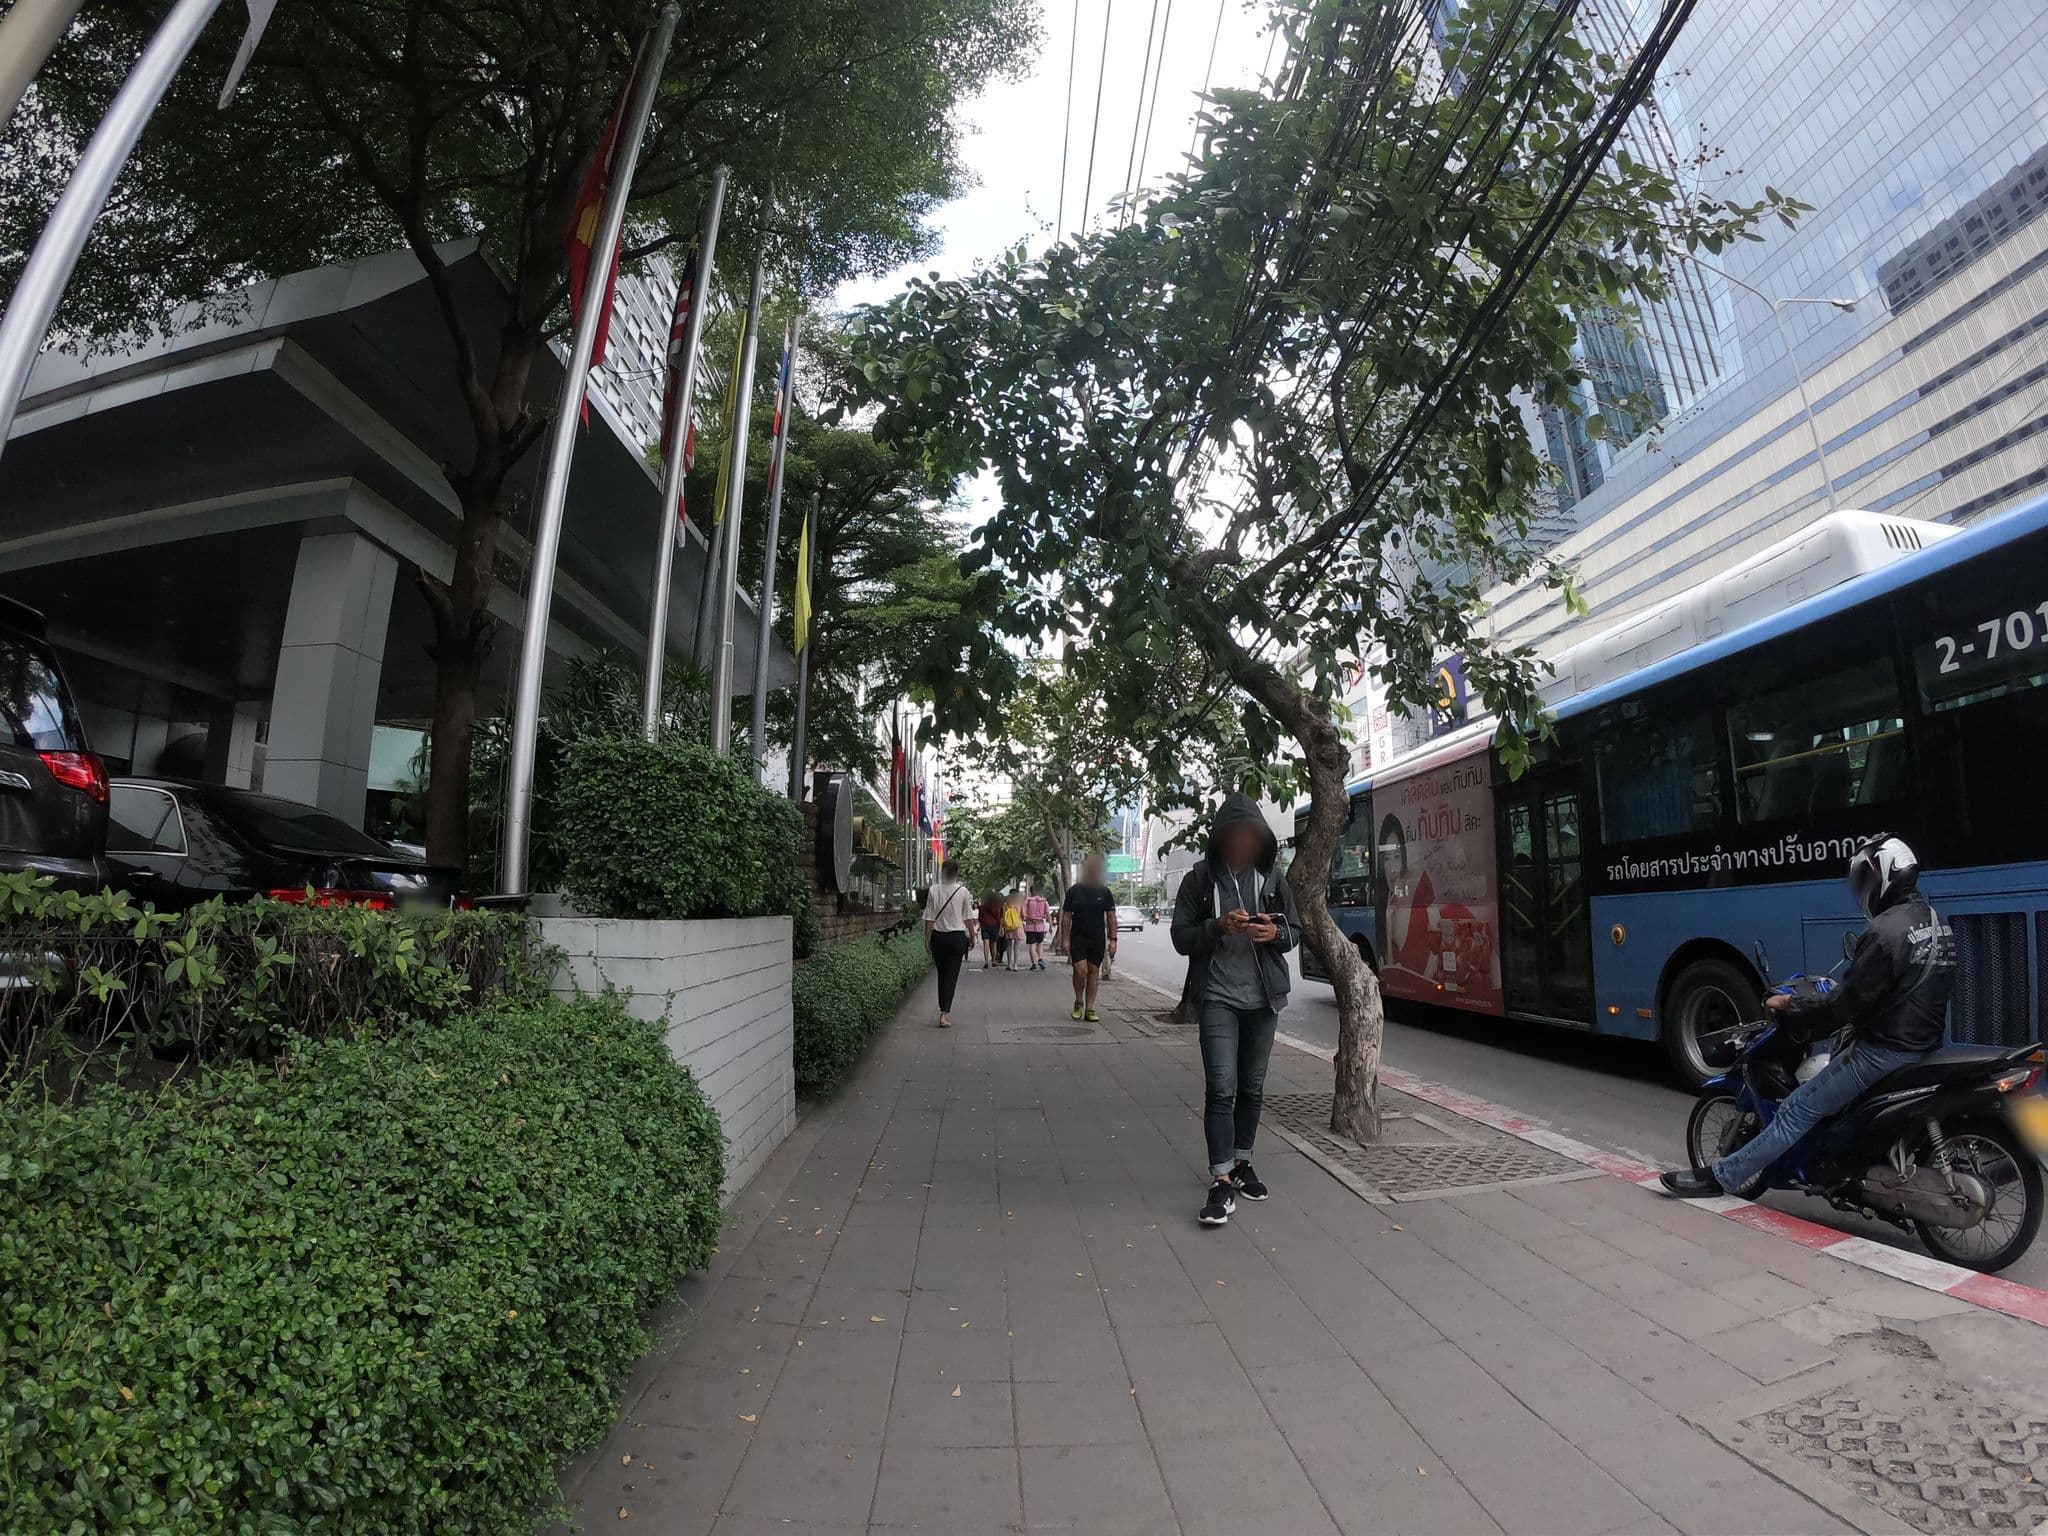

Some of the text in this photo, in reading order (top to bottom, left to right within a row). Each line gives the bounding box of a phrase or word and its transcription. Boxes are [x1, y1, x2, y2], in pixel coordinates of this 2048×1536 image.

[1606, 833, 1868, 881] รถโดยสารประจำทางปรับอาก
